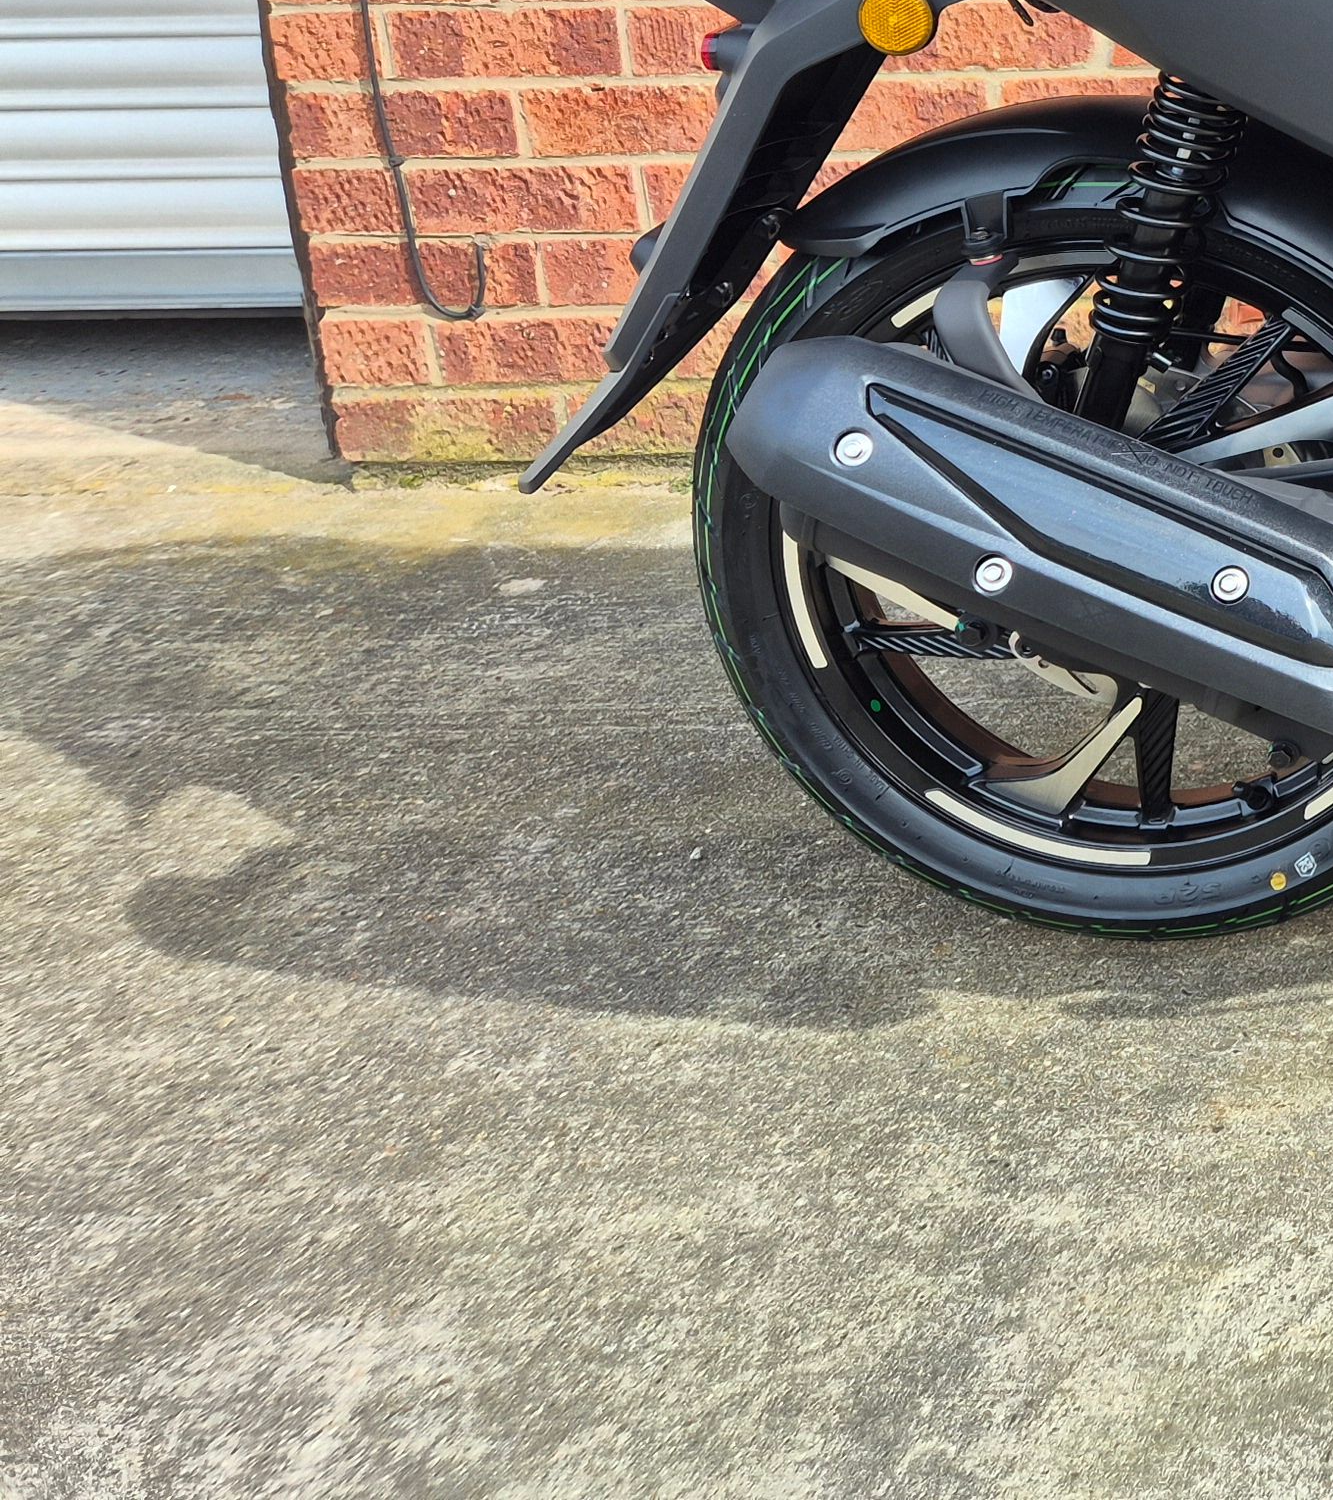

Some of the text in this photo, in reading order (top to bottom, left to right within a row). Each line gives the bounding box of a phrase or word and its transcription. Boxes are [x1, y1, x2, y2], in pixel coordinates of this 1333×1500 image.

[977, 389, 1021, 411] HIGH
[1164, 462, 1196, 481] NOT
[1204, 476, 1255, 505] TOUCH
